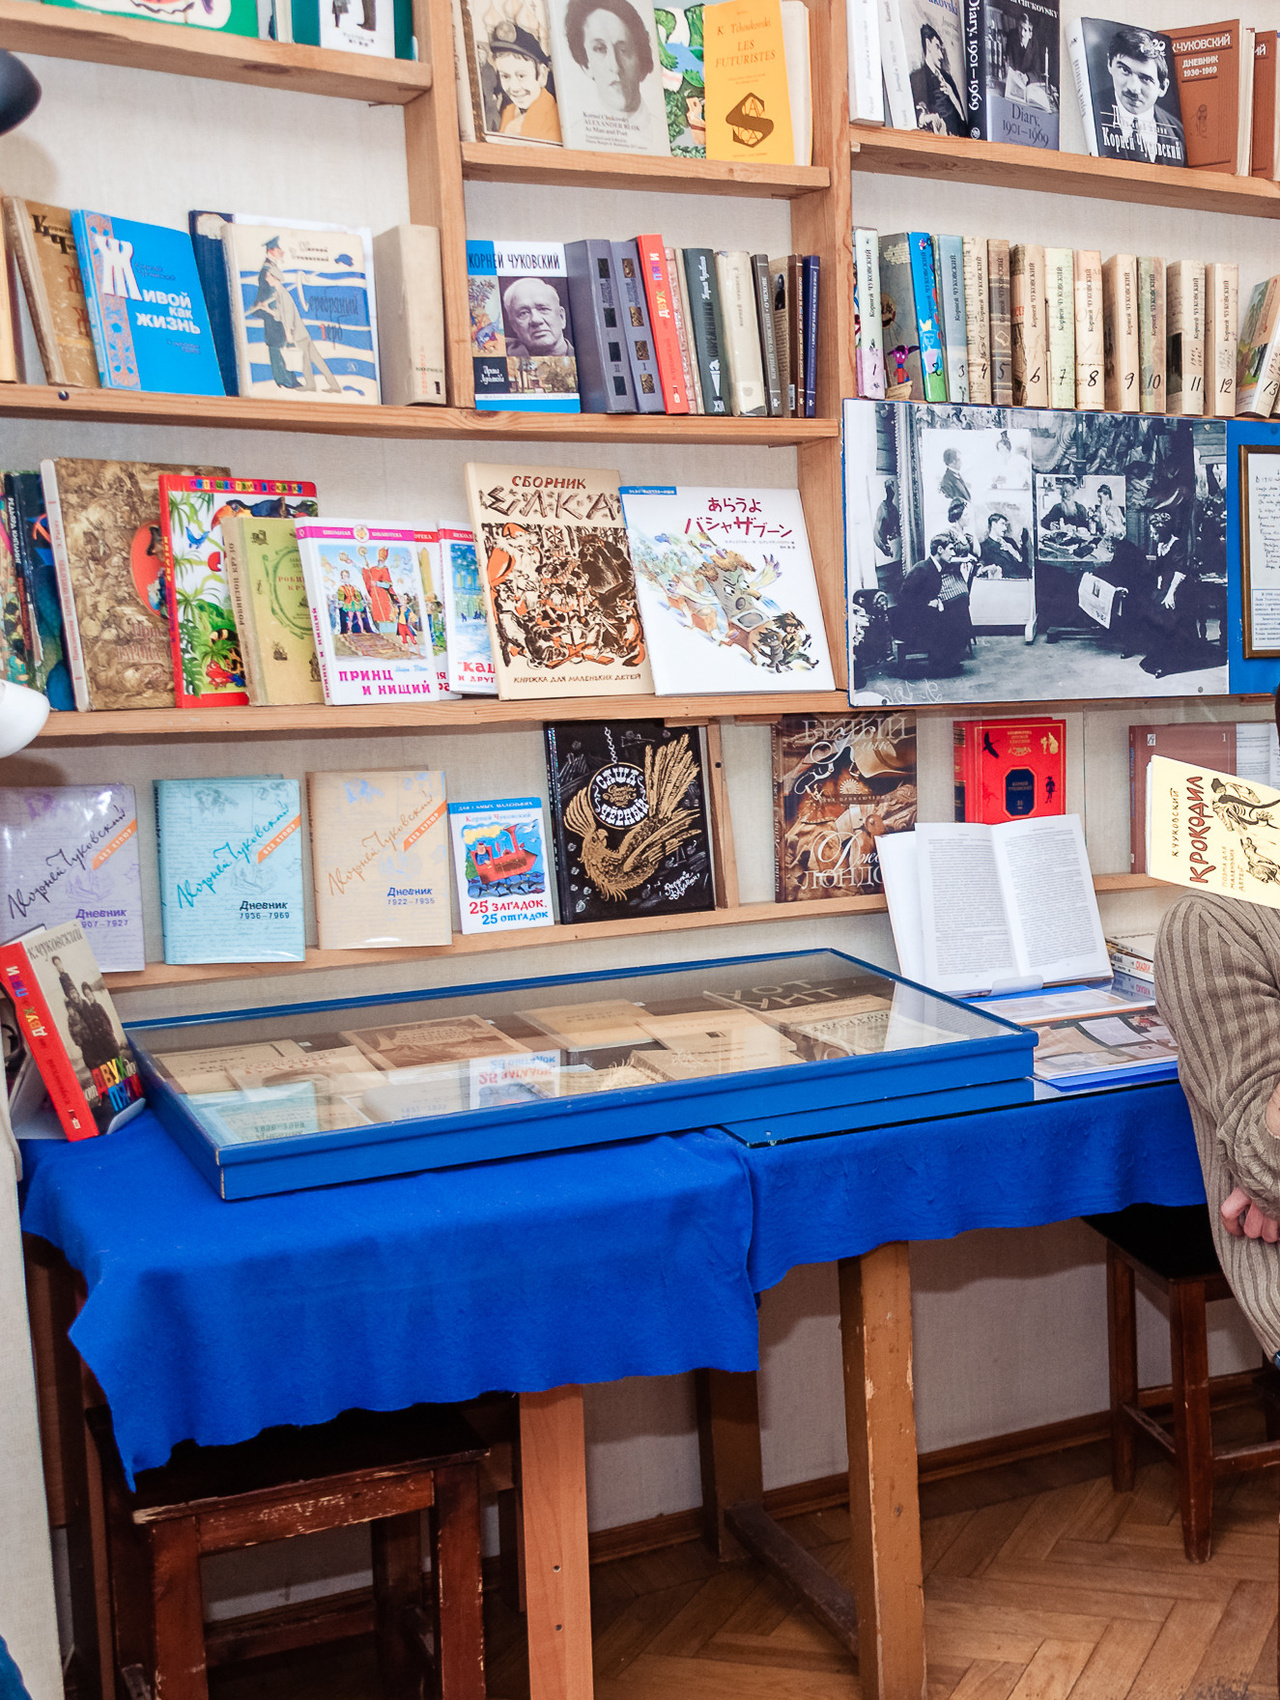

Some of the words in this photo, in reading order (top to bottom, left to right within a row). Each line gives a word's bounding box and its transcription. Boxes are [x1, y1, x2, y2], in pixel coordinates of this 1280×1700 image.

[737, 40, 755, 52] LES
[715, 50, 776, 68] FUTURISTES
[1182, 55, 1219, 68] ДНЕВНИК
[584, 120, 622, 129] ALEXANDER
[1011, 104, 1041, 129] Diary,
[468, 252, 504, 269] КОРНЕЙ
[507, 252, 561, 269] ЧУКОВСКИЙ
[650, 253, 663, 281] ПЯТИ
[169, 307, 194, 319] как
[657, 291, 670, 318] ДВУХ
[872, 364, 877, 376] 1
[932, 363, 942, 377] 2
[958, 364, 965, 378] 3
[981, 362, 987, 380] 4
[997, 363, 1010, 380] 5
[1029, 366, 1041, 384] 6
[1058, 368, 1067, 385] 7
[1087, 370, 1099, 387] 8
[1124, 372, 1134, 390] 9
[1146, 374, 1161, 390] 10
[1190, 376, 1202, 392] 11
[1219, 378, 1233, 394] 12
[1262, 380, 1278, 396] 13
[511, 475, 586, 490] СБОРНИК
[707, 497, 763, 514] あらうよ
[684, 516, 793, 539] バシャザブーン
[227, 543, 239, 575] КРУЗО
[233, 577, 245, 626] РОБИНЗОН
[311, 607, 323, 646] НИЩИЙ
[322, 664, 330, 699] ПРИНЦ
[339, 670, 394, 681] ПРИНЦ
[569, 674, 612, 682] МАЛЕНЬКИХ
[615, 672, 641, 680] ДЕТЕЙ
[378, 680, 431, 695] НИЩИЙ
[595, 766, 640, 790] САША
[496, 801, 533, 809] МАЛЕНЬКИХ
[600, 799, 650, 826] ЧЁРНЫЙ
[493, 812, 532, 820] Чуковский
[408, 833, 421, 844] БЕЗ
[420, 811, 439, 834] КУПЮР
[1186, 776, 1216, 884] КРОКОДИЛ
[98, 849, 112, 862] БЕЗ
[262, 845, 275, 858] БЕЗ
[801, 864, 884, 890] ЛОНДО
[387, 886, 433, 897] Дневник
[239, 899, 289, 911] Дневник
[469, 900, 489, 915] 25
[75, 908, 127, 921] Дневник
[482, 913, 498, 925] 25
[500, 911, 549, 922] ОТГАДОК
[23, 1006, 48, 1038] ДВУХ
[91, 1055, 127, 1099] ДВУХ
[108, 1073, 145, 1112] ПЯТИ
